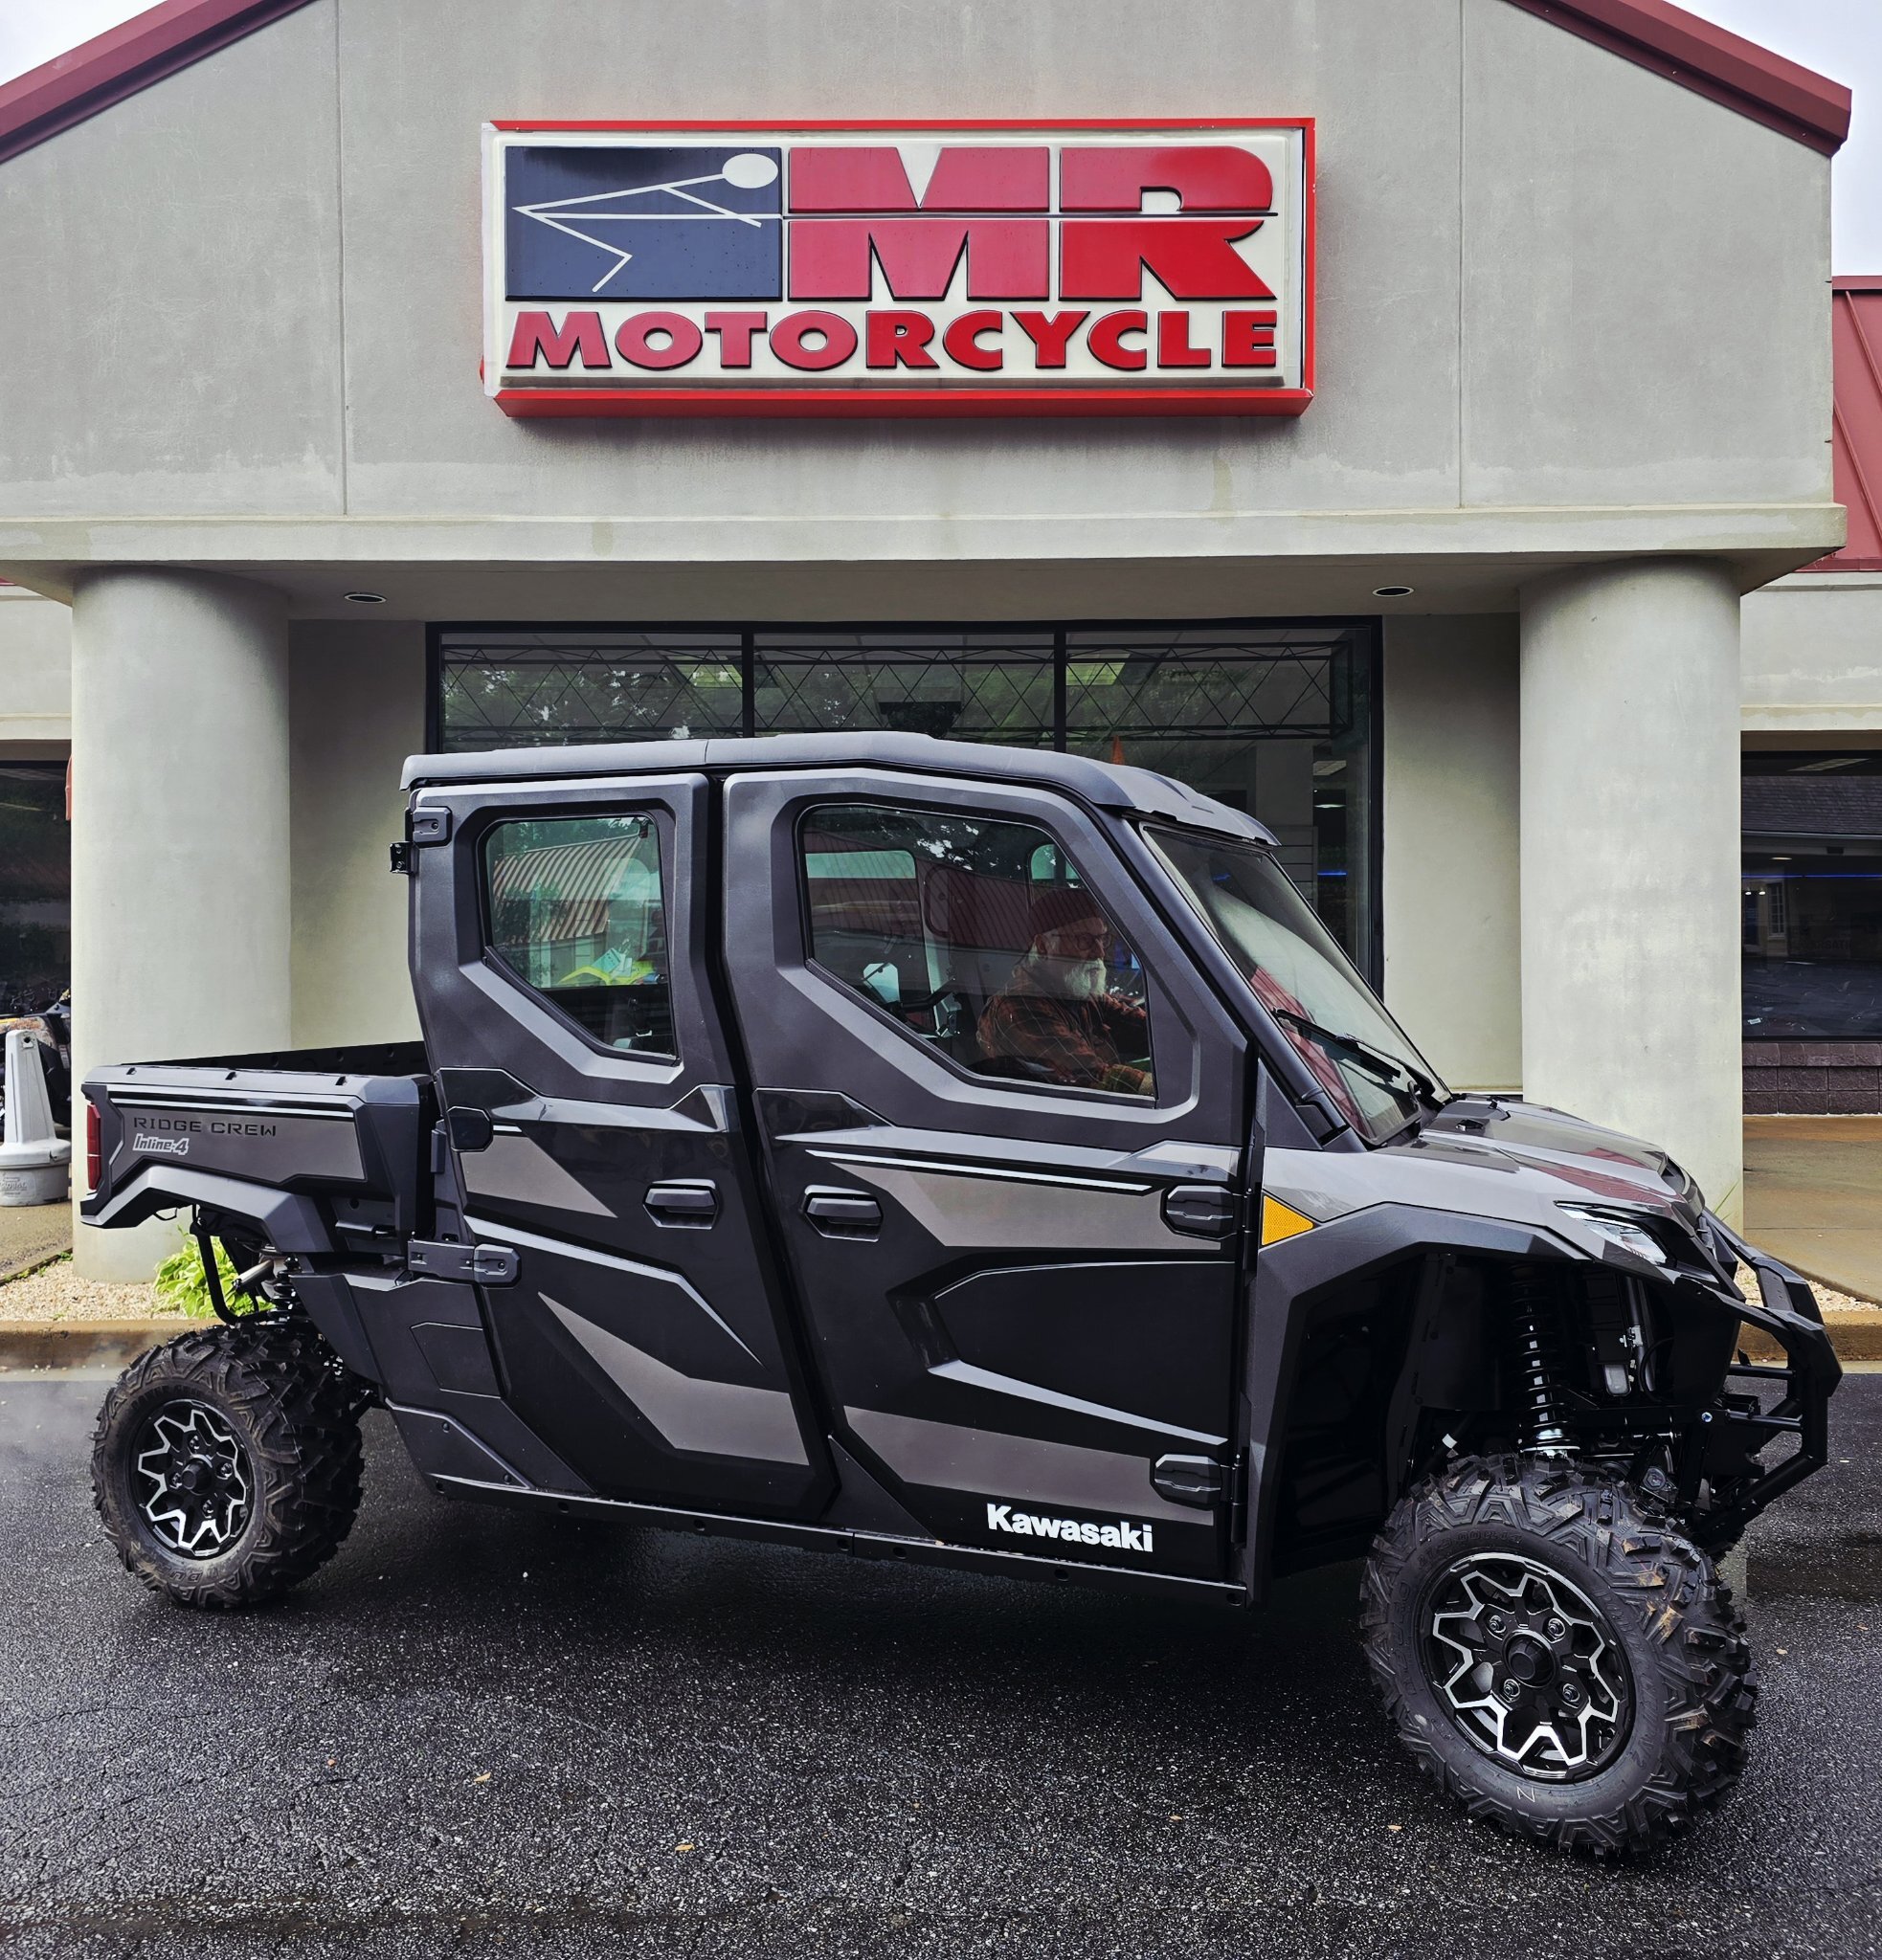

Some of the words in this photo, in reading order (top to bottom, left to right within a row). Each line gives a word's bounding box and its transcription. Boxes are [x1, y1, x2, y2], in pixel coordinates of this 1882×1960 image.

[787, 145, 1277, 302] MR
[505, 309, 1277, 371] MOTORCYCLE
[132, 1133, 190, 1156] Inline-4
[133, 1117, 202, 1133] RIDGE
[211, 1122, 277, 1137] CREW
[986, 1503, 1154, 1553] Kawasaki
